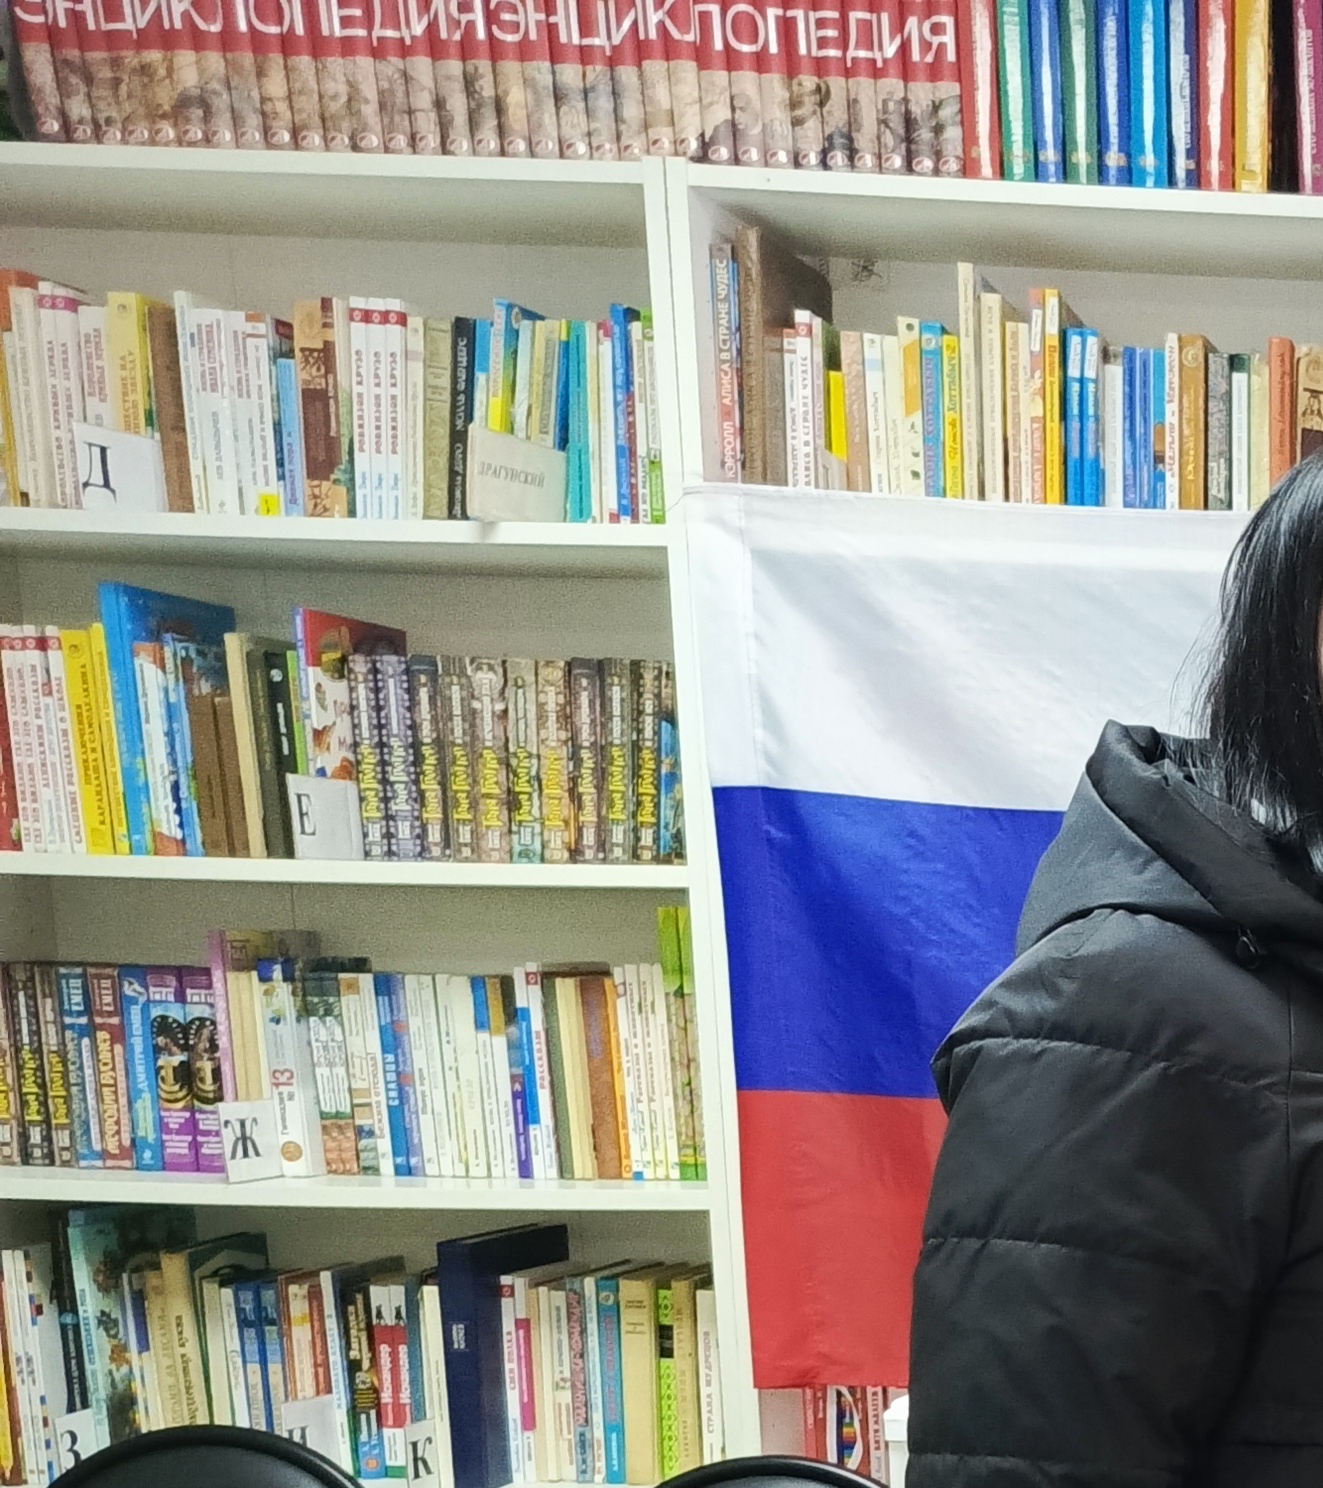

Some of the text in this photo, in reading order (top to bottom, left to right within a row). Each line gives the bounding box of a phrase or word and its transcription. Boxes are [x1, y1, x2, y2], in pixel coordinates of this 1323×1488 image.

[487, 0, 957, 64] ЭНЦИКЛОПЕДИЯ
[715, 257, 737, 479] КЭРРОЛЛ АЛИСА В СТРАНЕ ЧУДЕС
[80, 440, 118, 504] Д
[477, 461, 547, 490] ДРАГУНСКИЙ
[296, 792, 317, 837] Е
[271, 1068, 295, 1090] 13
[223, 1115, 265, 1161] Ж
[409, 1436, 435, 1479] К
